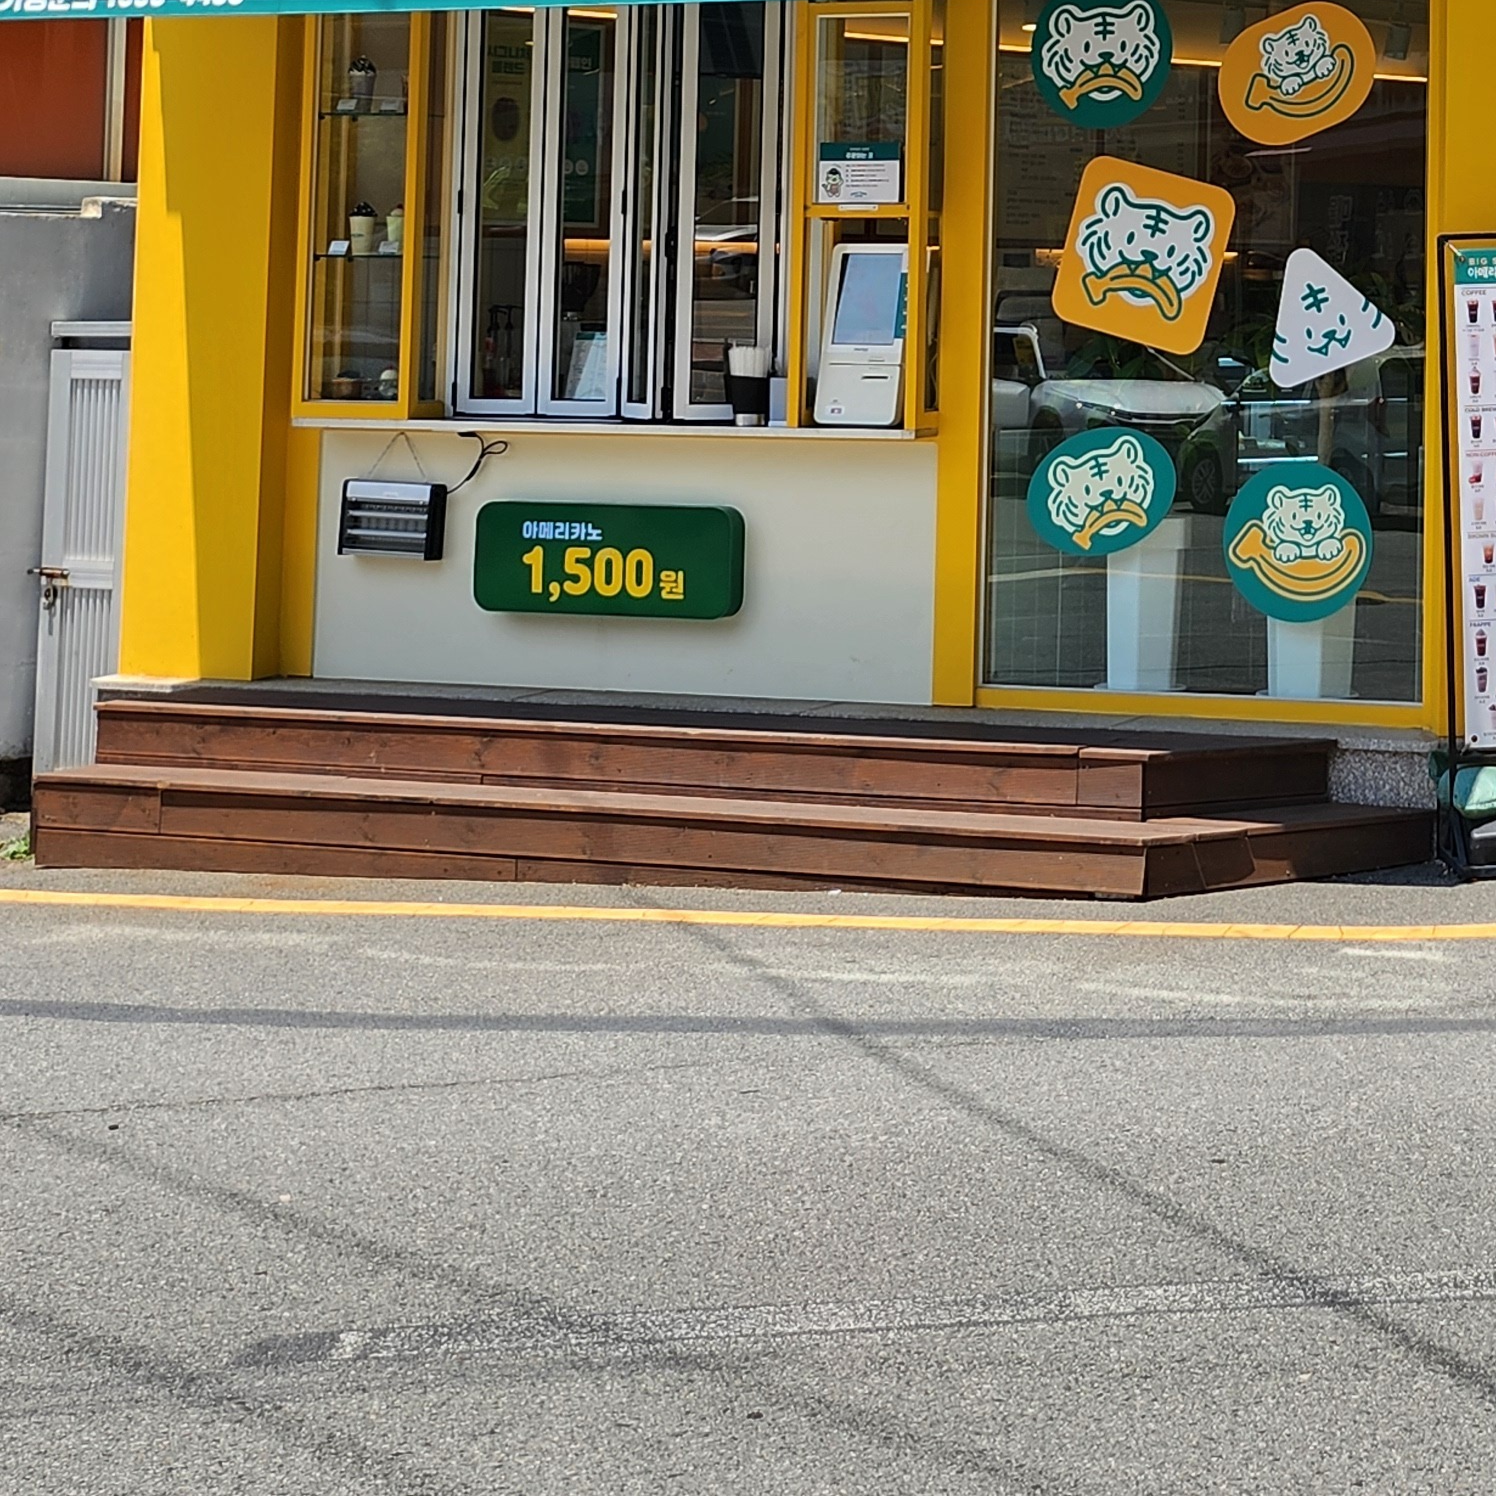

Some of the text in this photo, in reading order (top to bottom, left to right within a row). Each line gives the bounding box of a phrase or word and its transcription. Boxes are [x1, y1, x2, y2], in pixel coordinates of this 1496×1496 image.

[1468, 257, 1487, 265] BIG
[522, 521, 603, 541] 아메리카노
[521, 545, 685, 602] 1,500 원
